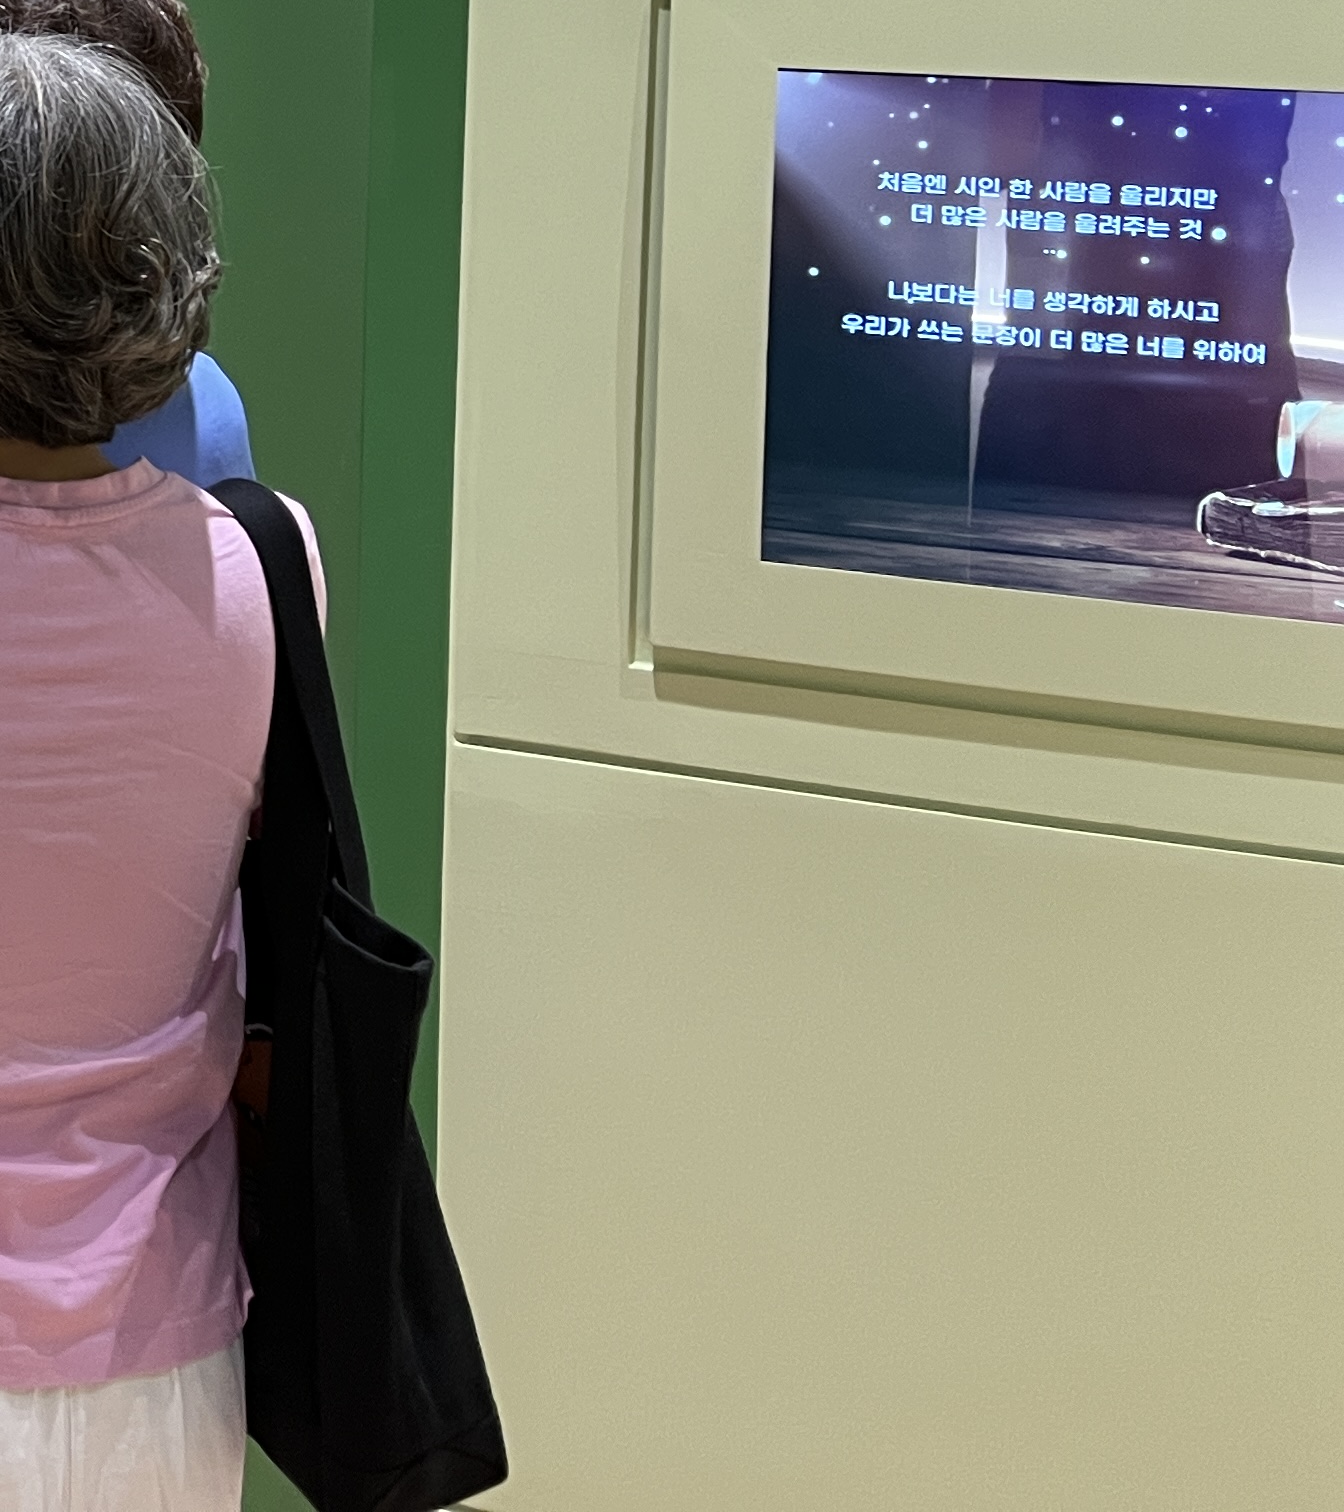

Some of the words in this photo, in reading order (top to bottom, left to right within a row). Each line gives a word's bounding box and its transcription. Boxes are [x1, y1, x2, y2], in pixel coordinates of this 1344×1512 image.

[877, 171, 947, 195] 처음엔
[954, 176, 1001, 198] 시인
[1008, 178, 1033, 200] 한
[1040, 180, 1112, 205] 사람을
[1119, 183, 1218, 210] 울리지만
[911, 203, 933, 224] 더
[941, 205, 987, 227] 많은
[995, 208, 1066, 233] 사람을
[1075, 212, 1170, 239] 울려주는
[1179, 218, 1203, 240] 것
[887, 280, 980, 306] 나보다는
[989, 287, 1035, 311] 너를
[1042, 290, 1140, 319] 생각하게
[1146, 298, 1220, 323] 하시고
[840, 312, 911, 339] 우리가
[916, 318, 963, 343] 쓰는
[971, 322, 1041, 349] 문장이
[1049, 329, 1073, 351] 더
[1080, 330, 1129, 356] 많은
[1136, 335, 1185, 360] 너를
[1192, 339, 1267, 365] 위하여
